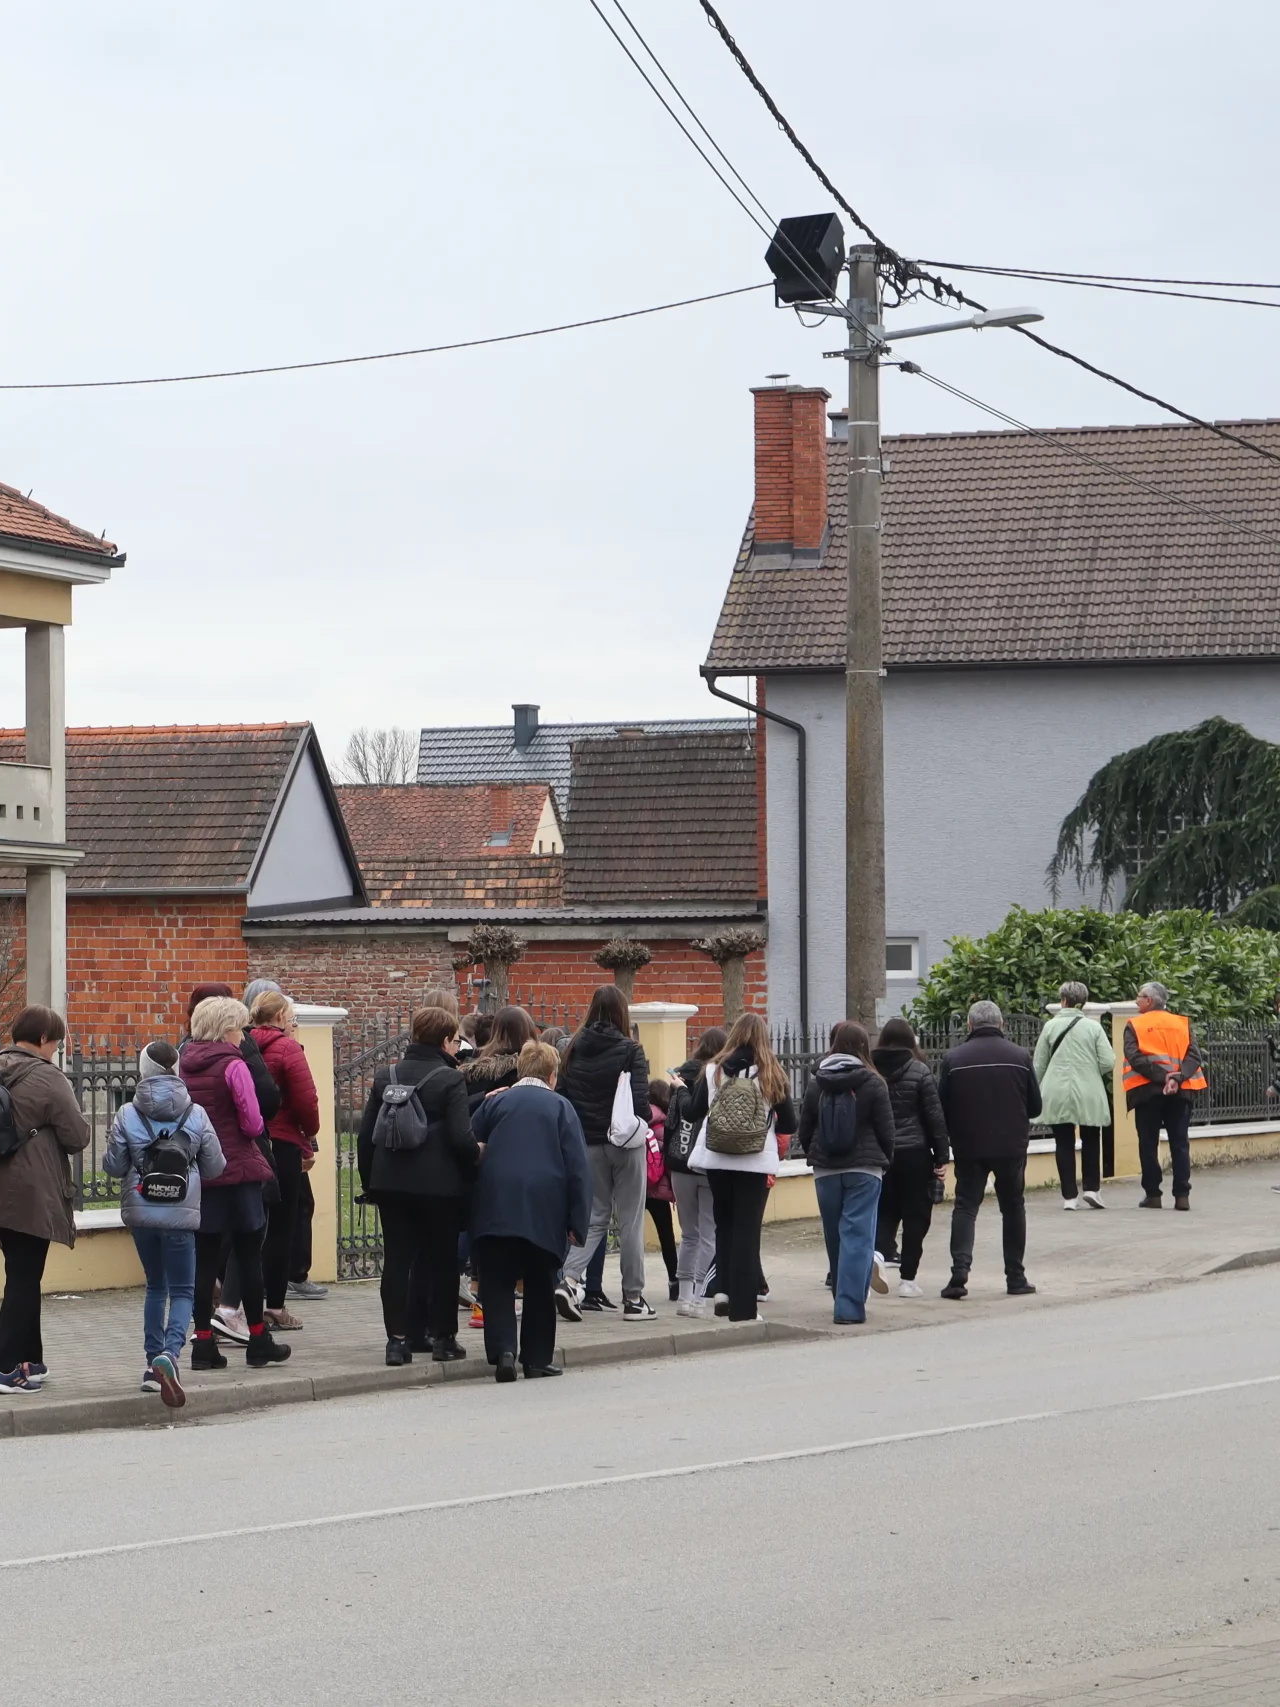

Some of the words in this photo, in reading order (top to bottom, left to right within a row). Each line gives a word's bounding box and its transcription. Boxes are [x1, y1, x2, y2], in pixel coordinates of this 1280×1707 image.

[680, 1119, 693, 1155] adid
[147, 1184, 181, 1192] MICKEY
[147, 1190, 180, 1198] MOUSE
